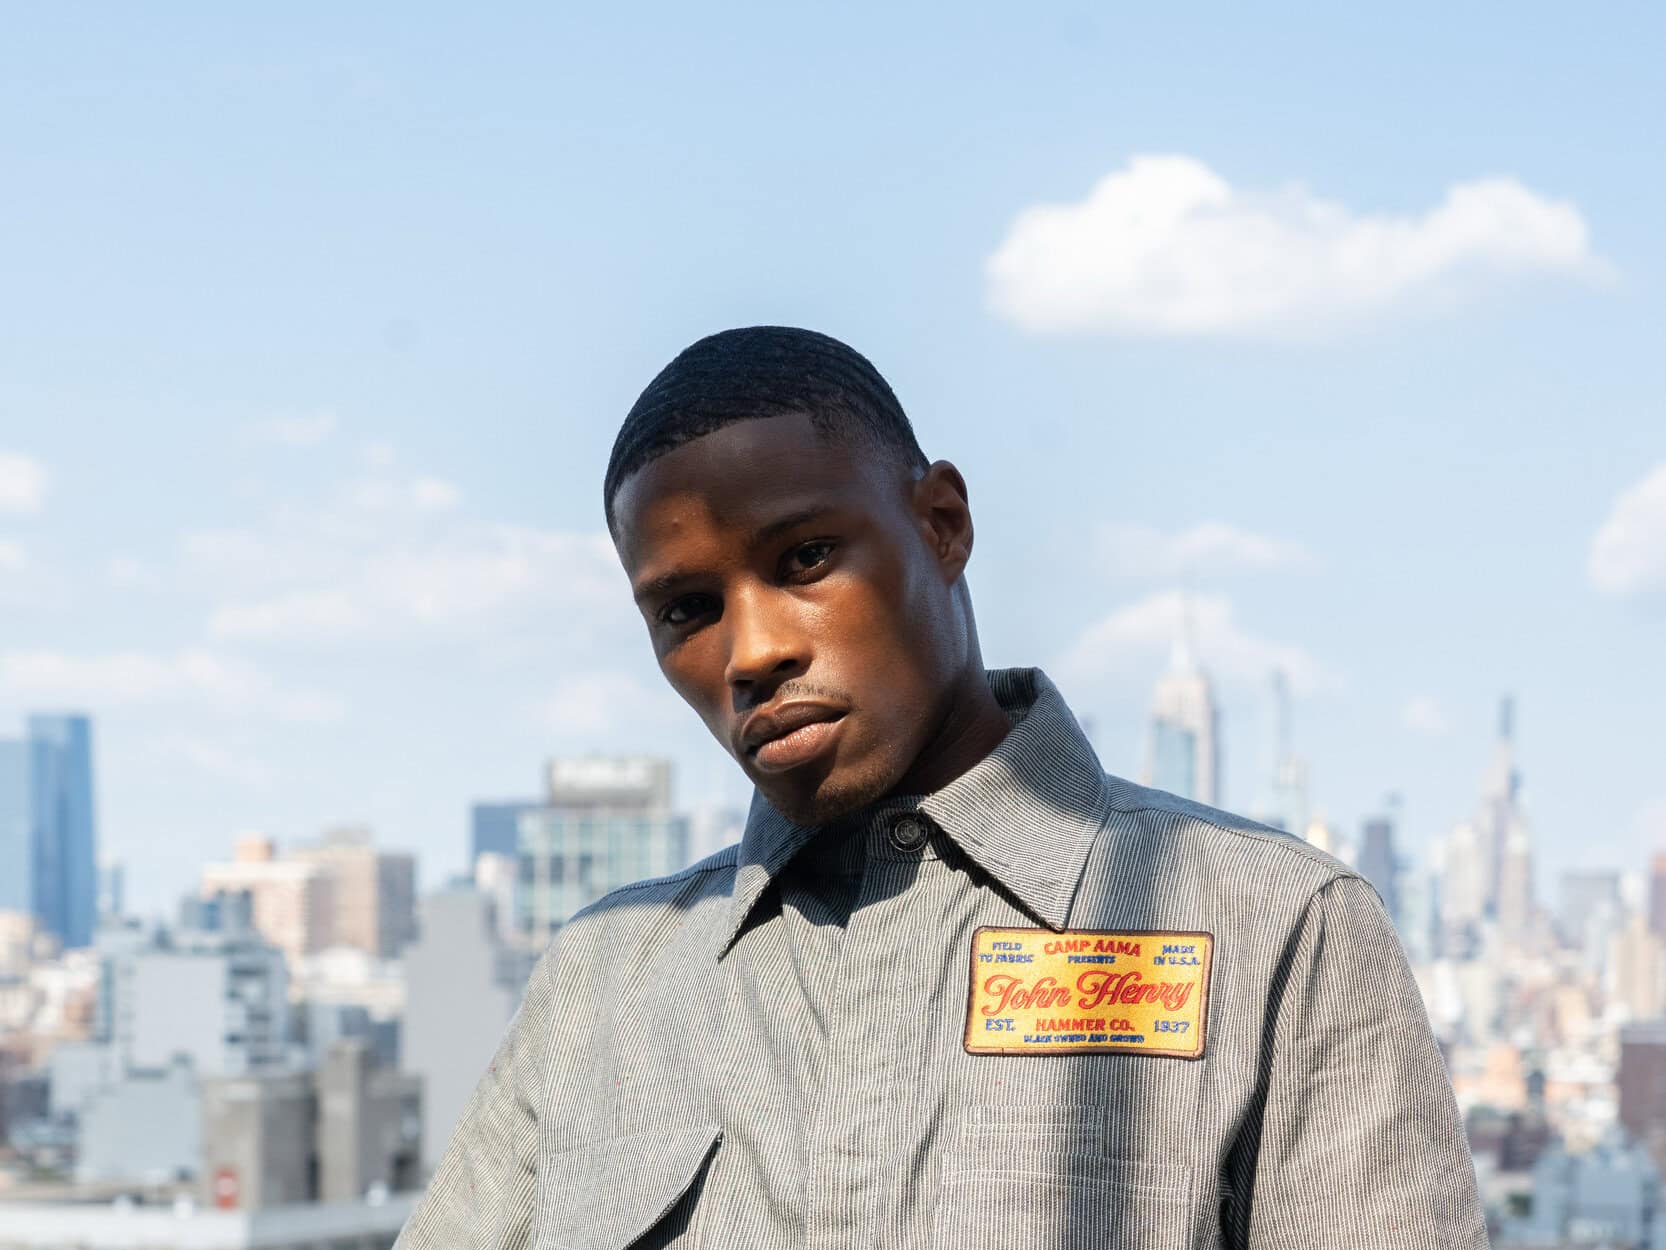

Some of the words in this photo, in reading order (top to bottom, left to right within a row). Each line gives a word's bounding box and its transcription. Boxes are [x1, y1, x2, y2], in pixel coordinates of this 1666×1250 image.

[992, 942, 1022, 951] FIELD
[1044, 940, 1090, 955] CAMP
[1093, 939, 1141, 957] AAMA
[1162, 945, 1195, 955] MADE
[979, 954, 992, 962] TO
[995, 954, 1034, 963] FABRIC
[1068, 955, 1116, 964] PRESENTS
[1153, 956, 1165, 965] IN
[981, 974, 1072, 1016] John
[1076, 970, 1194, 1011] Henry
[985, 1018, 1015, 1031] EST.
[1035, 1018, 1105, 1031] HAMMER
[1109, 1019, 1135, 1031] CO.
[1088, 1034, 1107, 1042] AND
